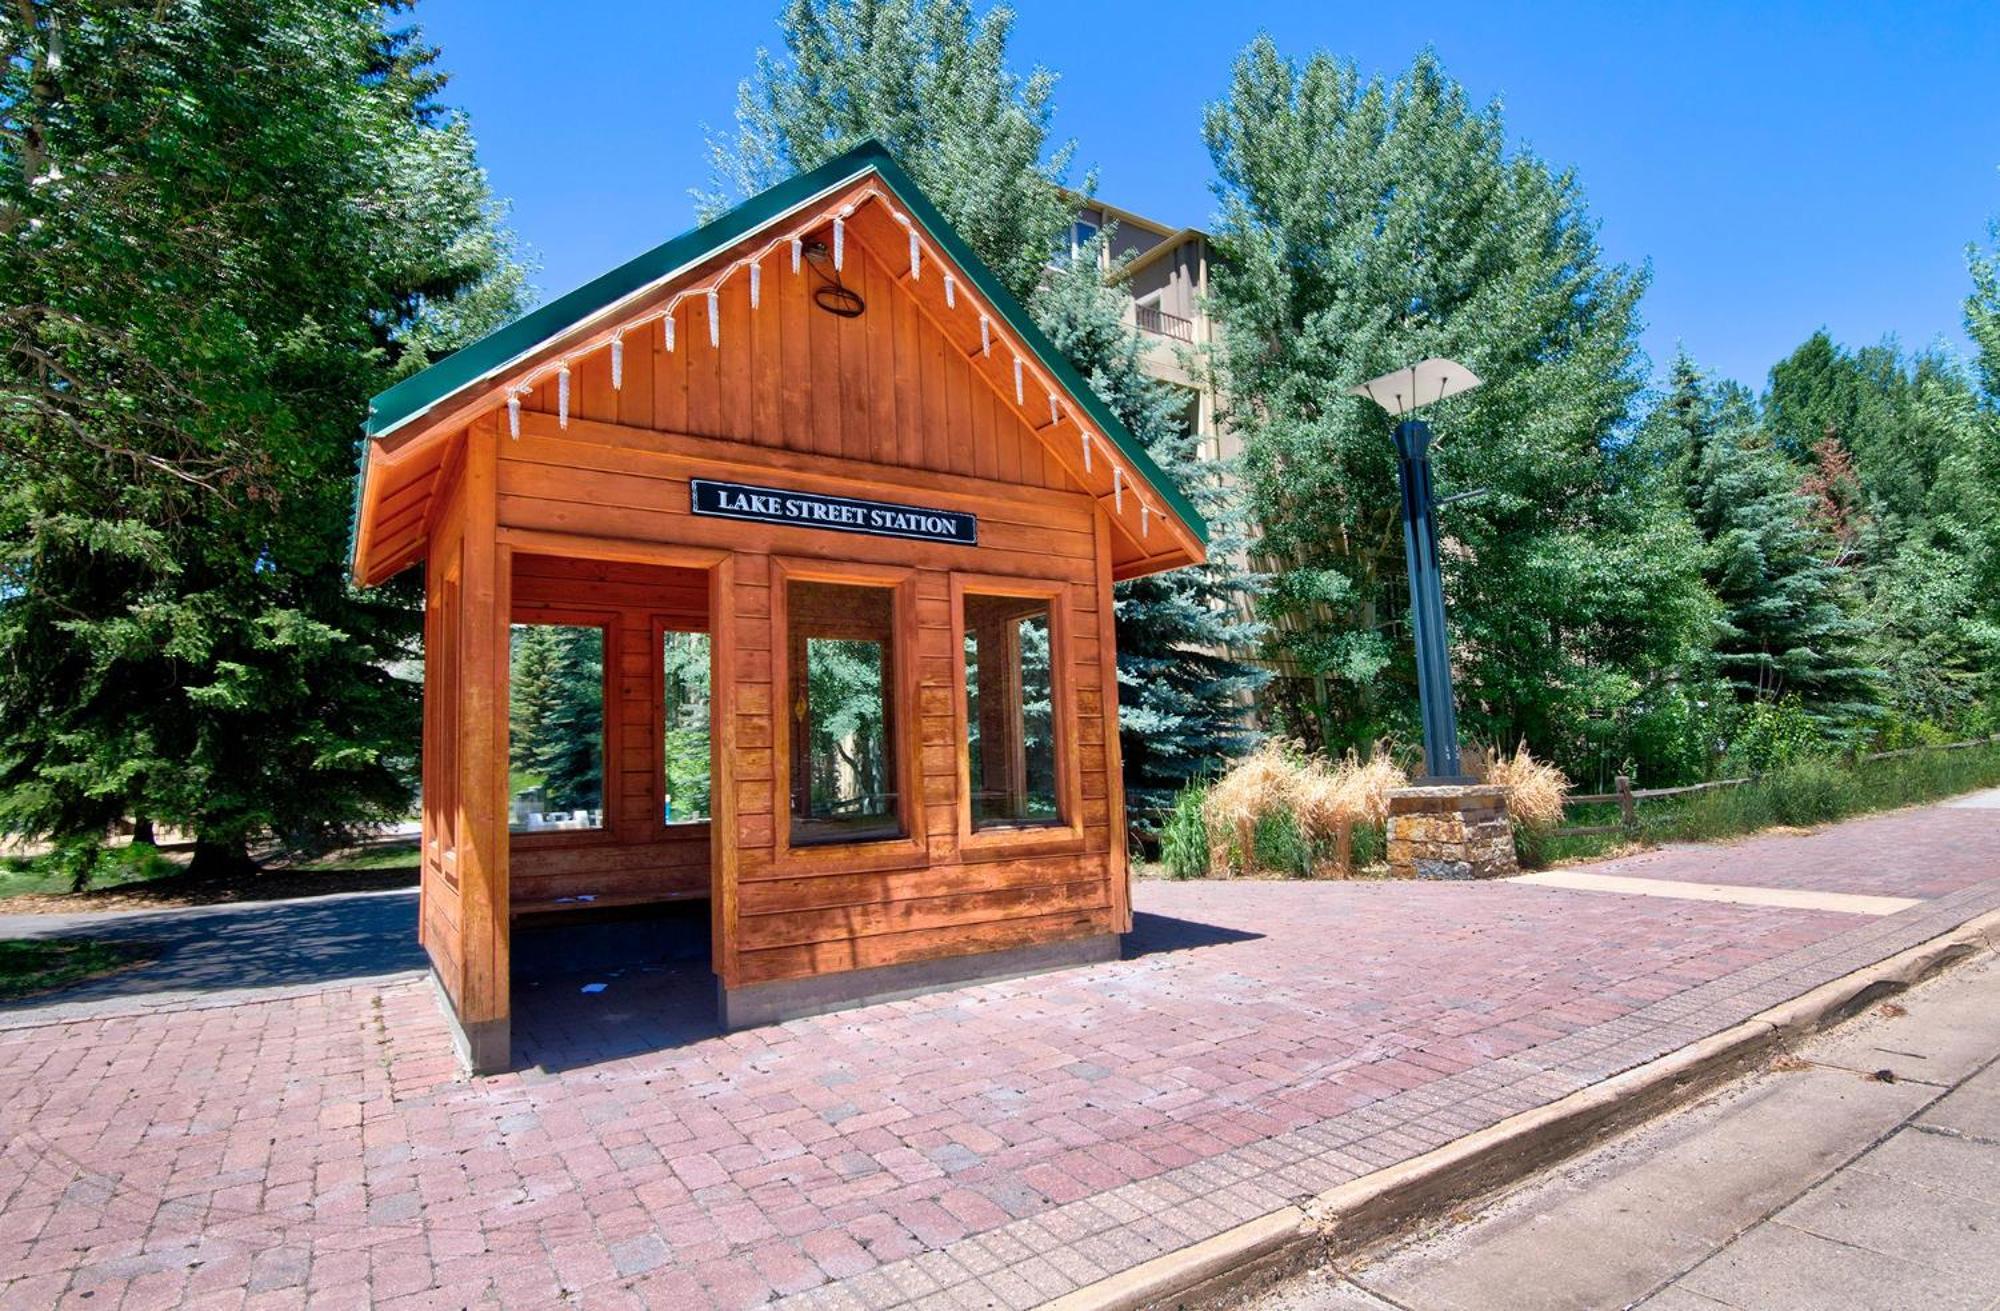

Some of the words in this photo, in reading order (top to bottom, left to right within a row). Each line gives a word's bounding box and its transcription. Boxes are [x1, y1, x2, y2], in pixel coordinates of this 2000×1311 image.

[718, 490, 782, 515] LAKE
[785, 499, 867, 525] STREET
[871, 510, 957, 535] STATION
